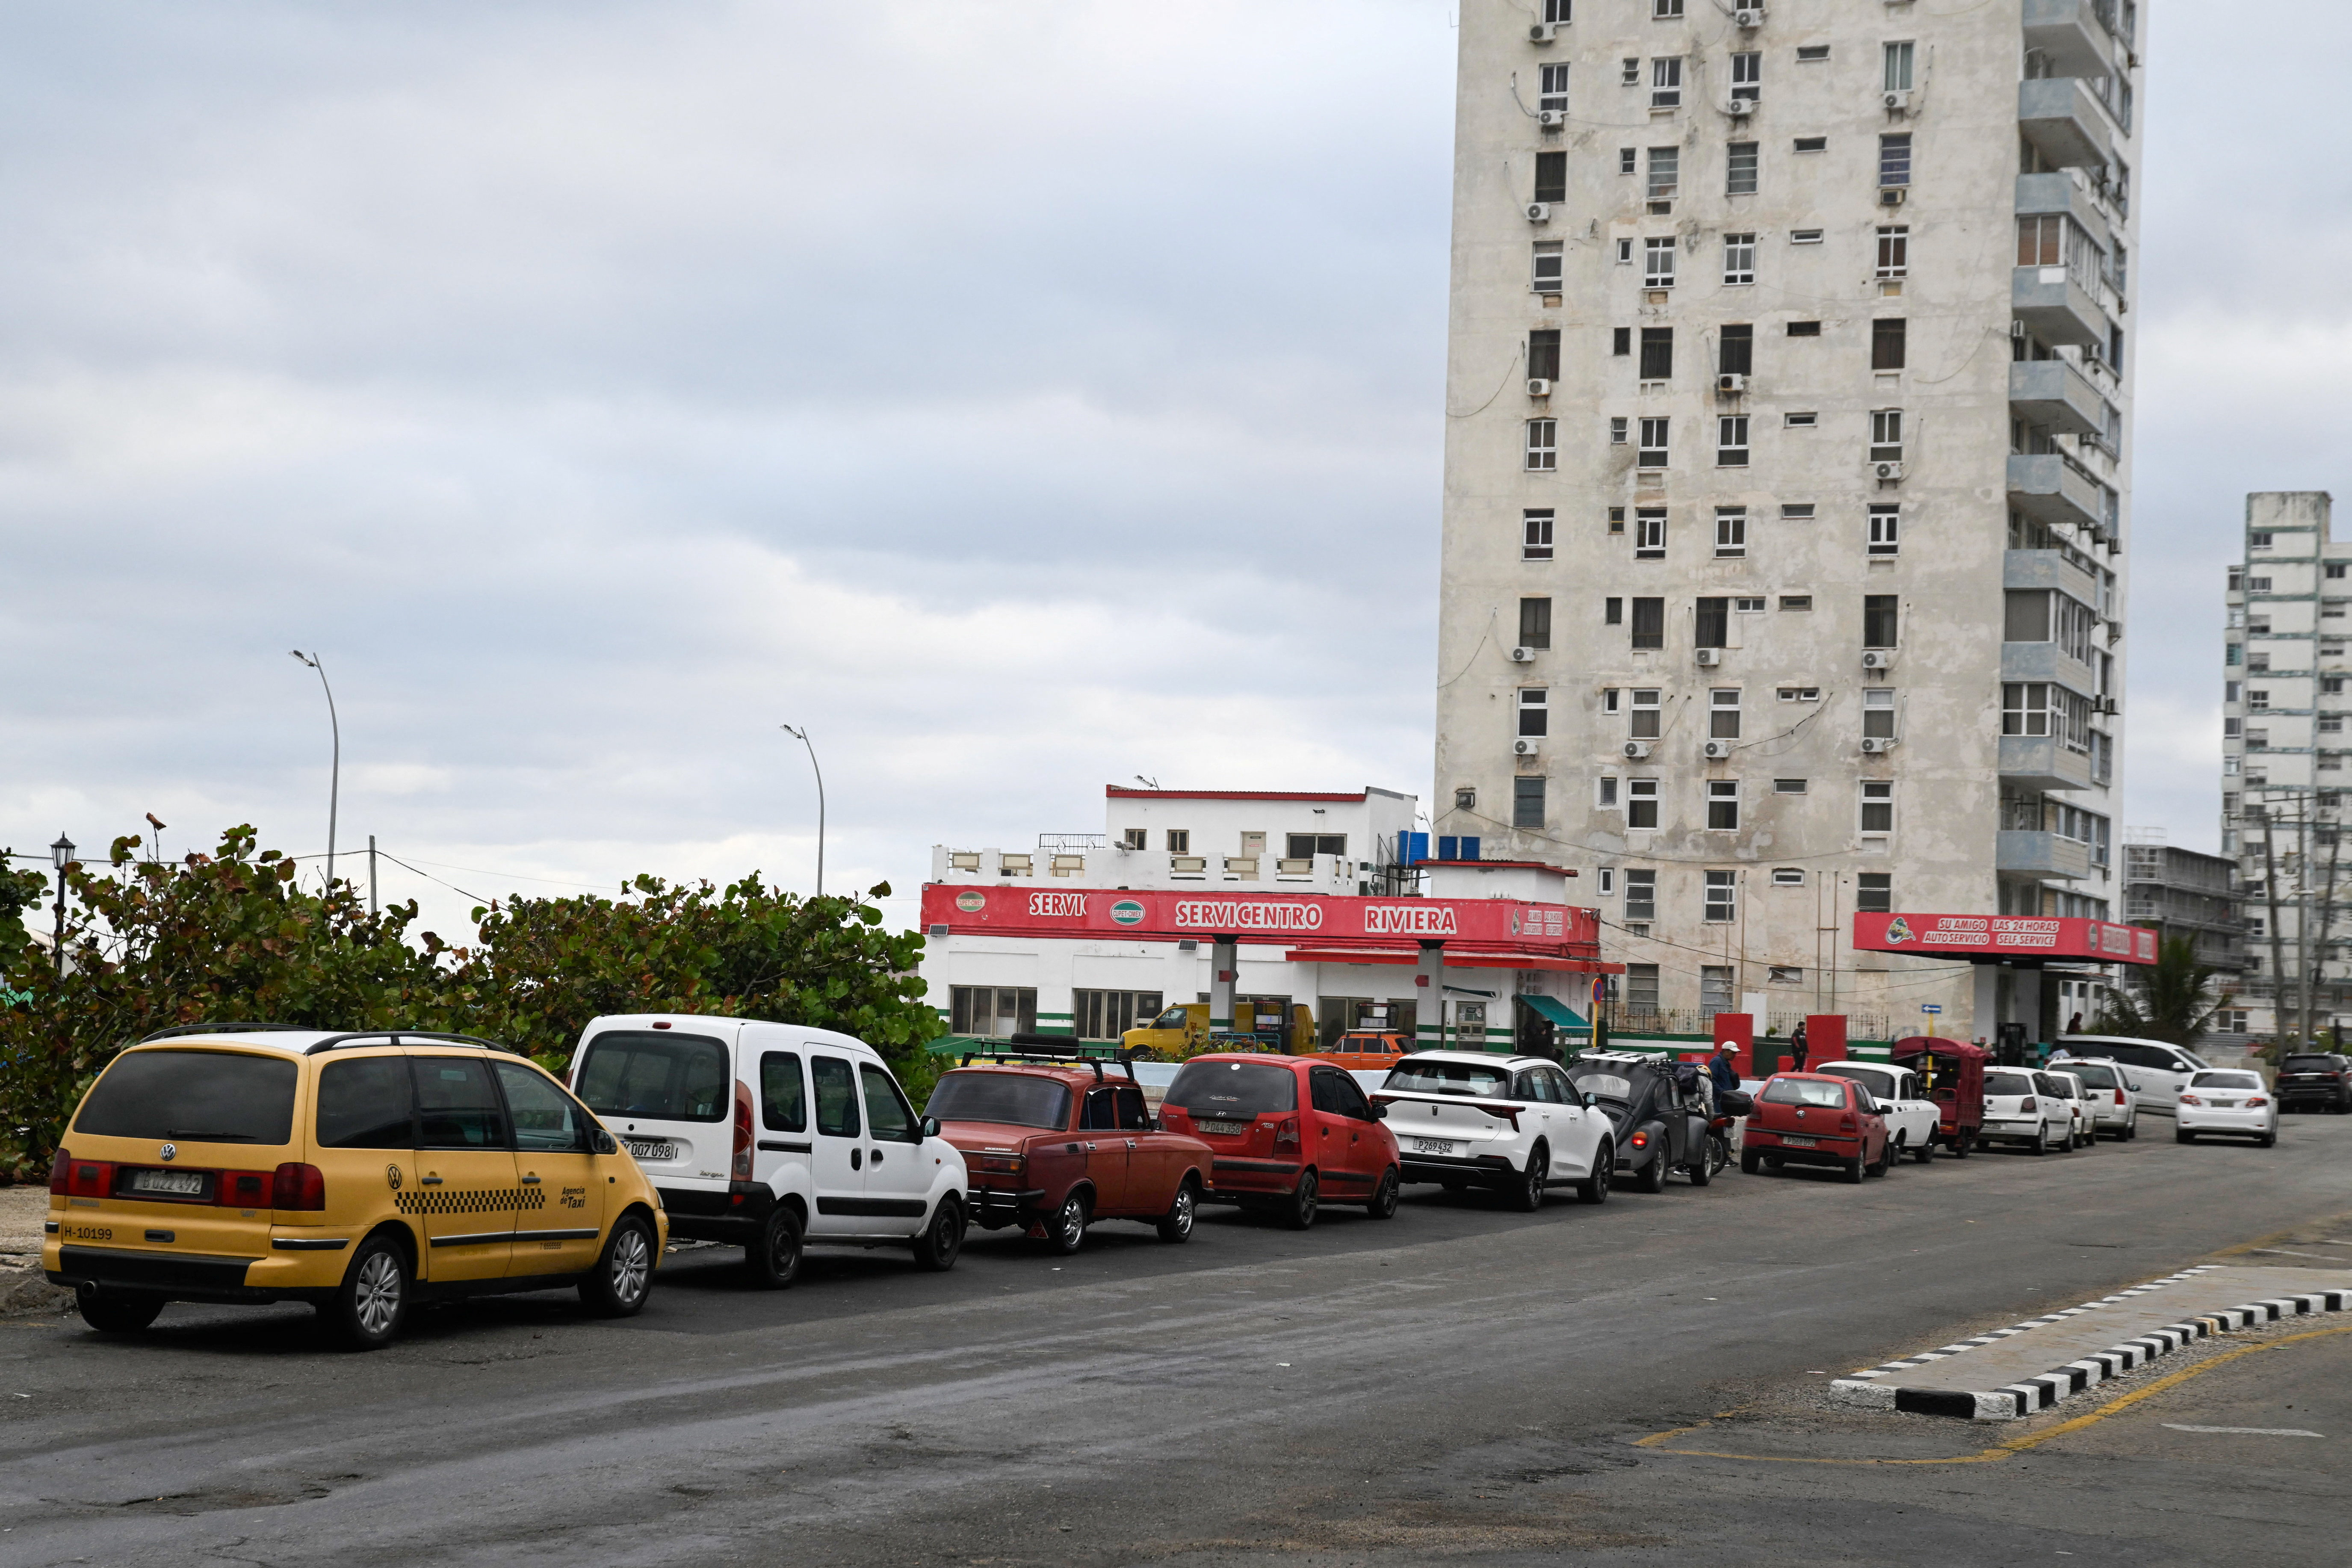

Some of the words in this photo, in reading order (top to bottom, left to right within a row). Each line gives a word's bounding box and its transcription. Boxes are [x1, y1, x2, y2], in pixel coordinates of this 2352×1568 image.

[1030, 893, 1087, 915] SERVI
[1177, 902, 1321, 928] SERVICENTRO
[1366, 907, 1456, 933] RIVIERA
[1939, 919, 1951, 929] SU
[1954, 920, 1987, 930] AMIGO
[1994, 920, 2010, 930] LAS
[2013, 921, 2024, 931] 24
[2026, 921, 2058, 932] HORAS
[1998, 935, 2018, 944] SELF
[2020, 935, 2054, 945] SERVICE
[631, 1143, 650, 1156] 007
[651, 1145, 671, 1157] 098
[561, 1186, 585, 1197] Agencia
[560, 1196, 567, 1205] de
[567, 1196, 585, 1208] Taxi
[65, 1226, 112, 1240] H-10199
